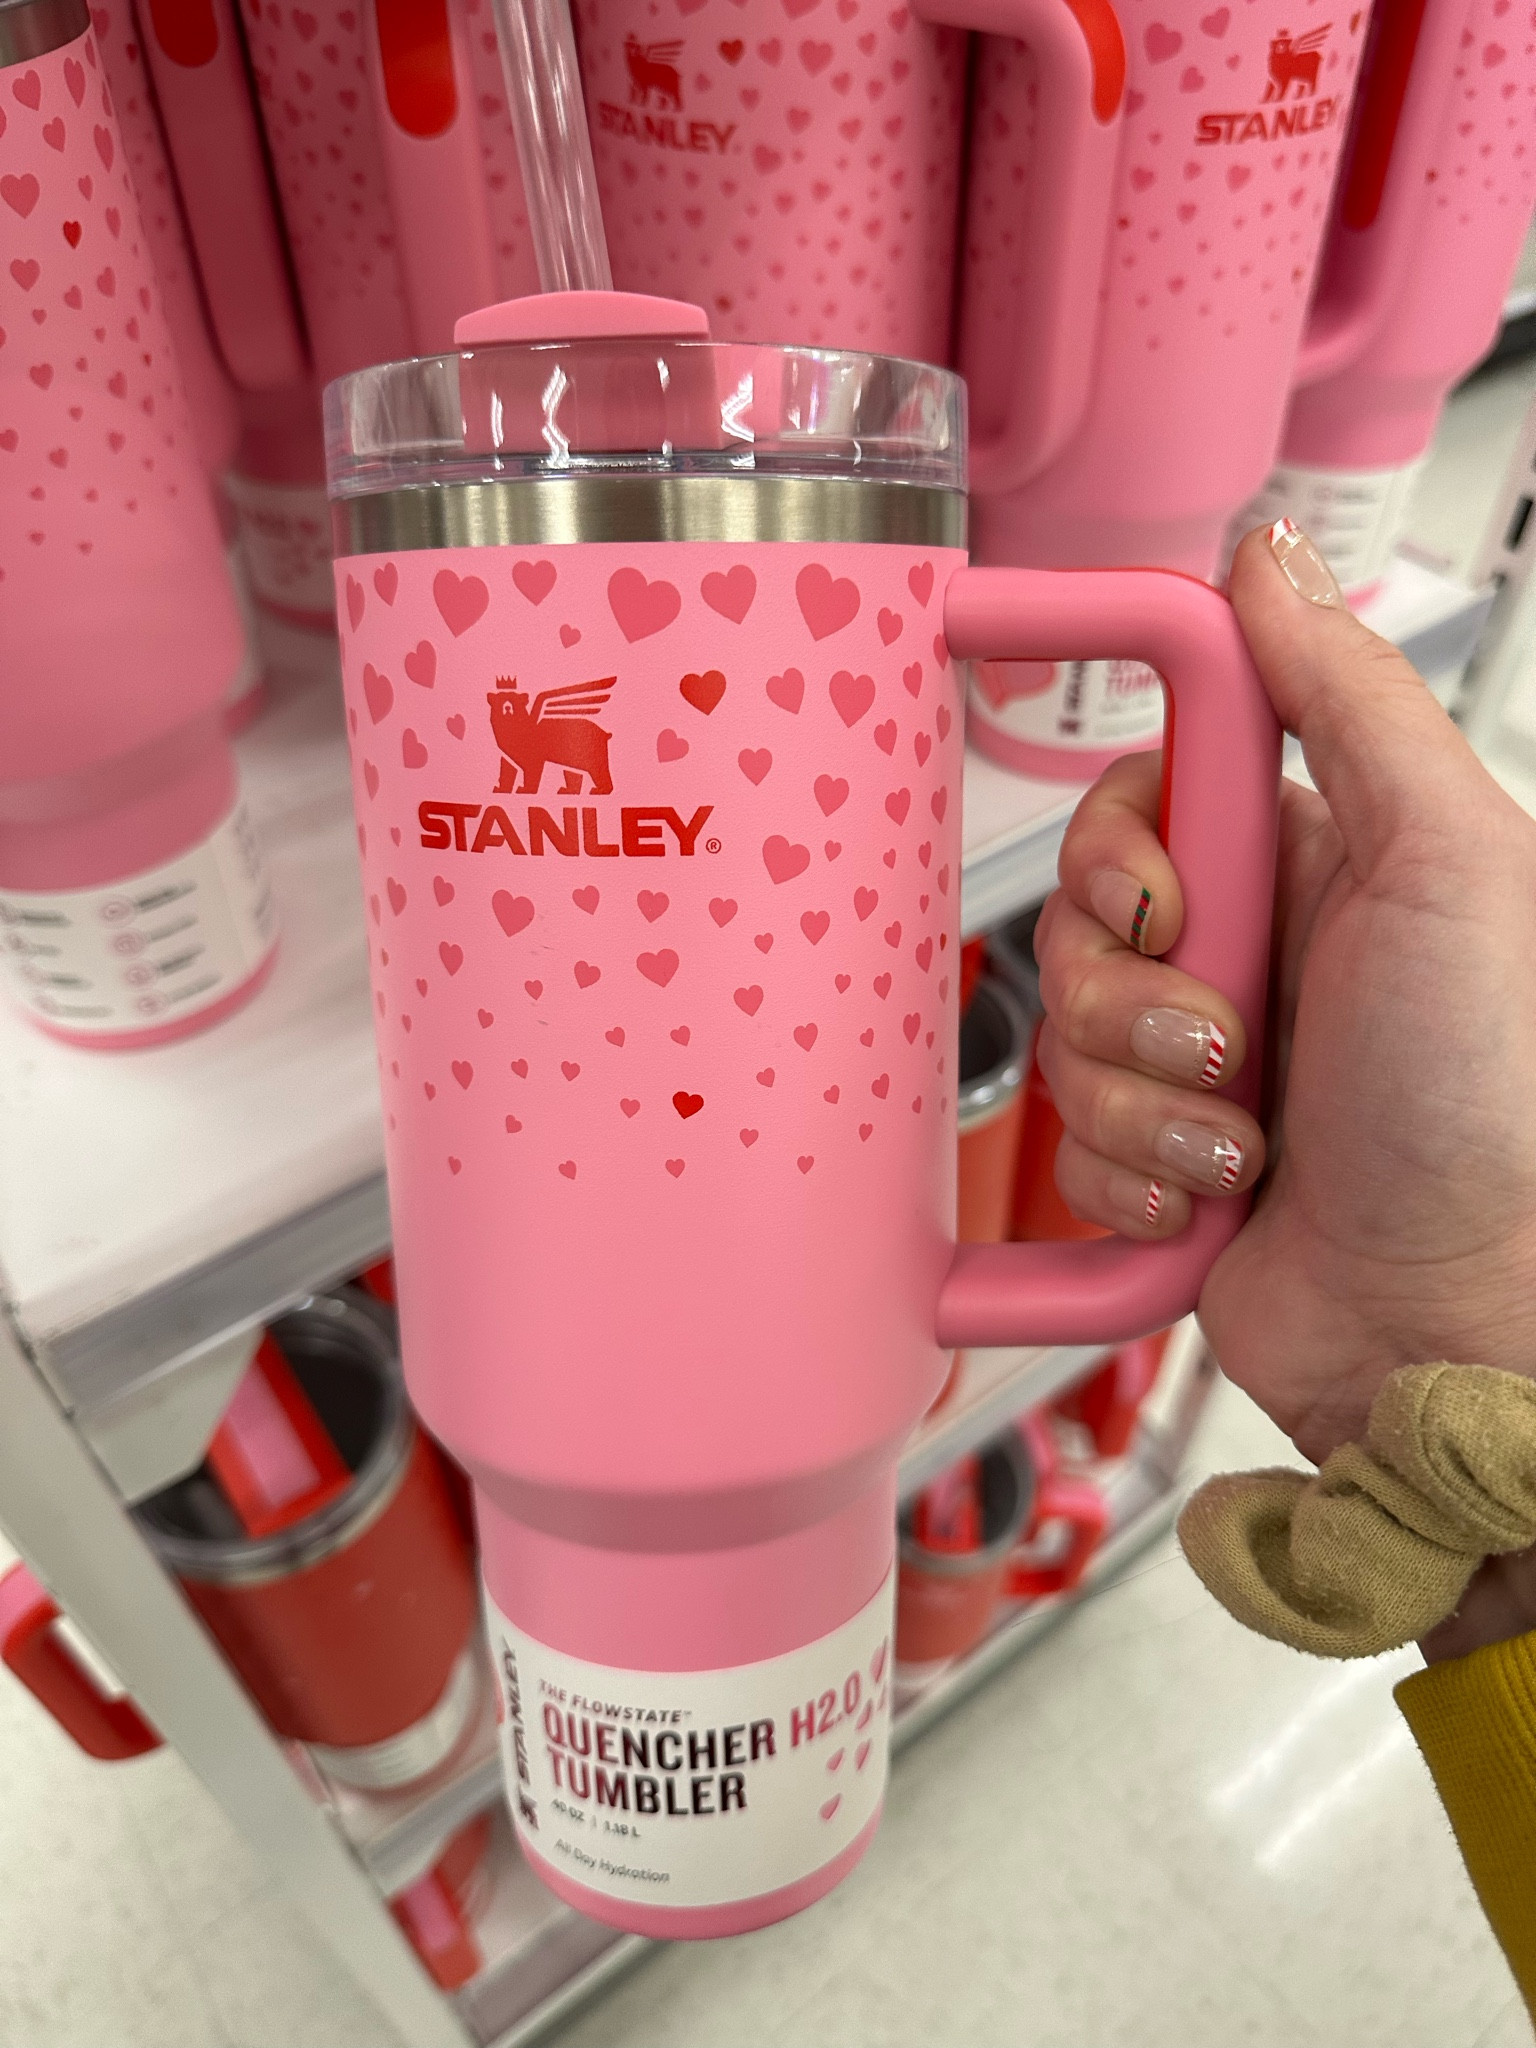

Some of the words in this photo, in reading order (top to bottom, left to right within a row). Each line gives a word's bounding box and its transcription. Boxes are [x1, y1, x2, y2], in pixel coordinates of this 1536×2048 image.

[1195, 94, 1343, 146] STANLEY
[539, 1678, 567, 1701] THE
[543, 1701, 776, 1771] QUENCHER
[790, 1671, 862, 1748] H2.0
[547, 1743, 748, 1816] TUMBLER
[551, 1799, 567, 1812] 40
[569, 1806, 584, 1821] OZ
[632, 1826, 641, 1837] L
[555, 1838, 571, 1853] All
[573, 1846, 597, 1868] Day
[599, 1858, 670, 1882] Hydration
